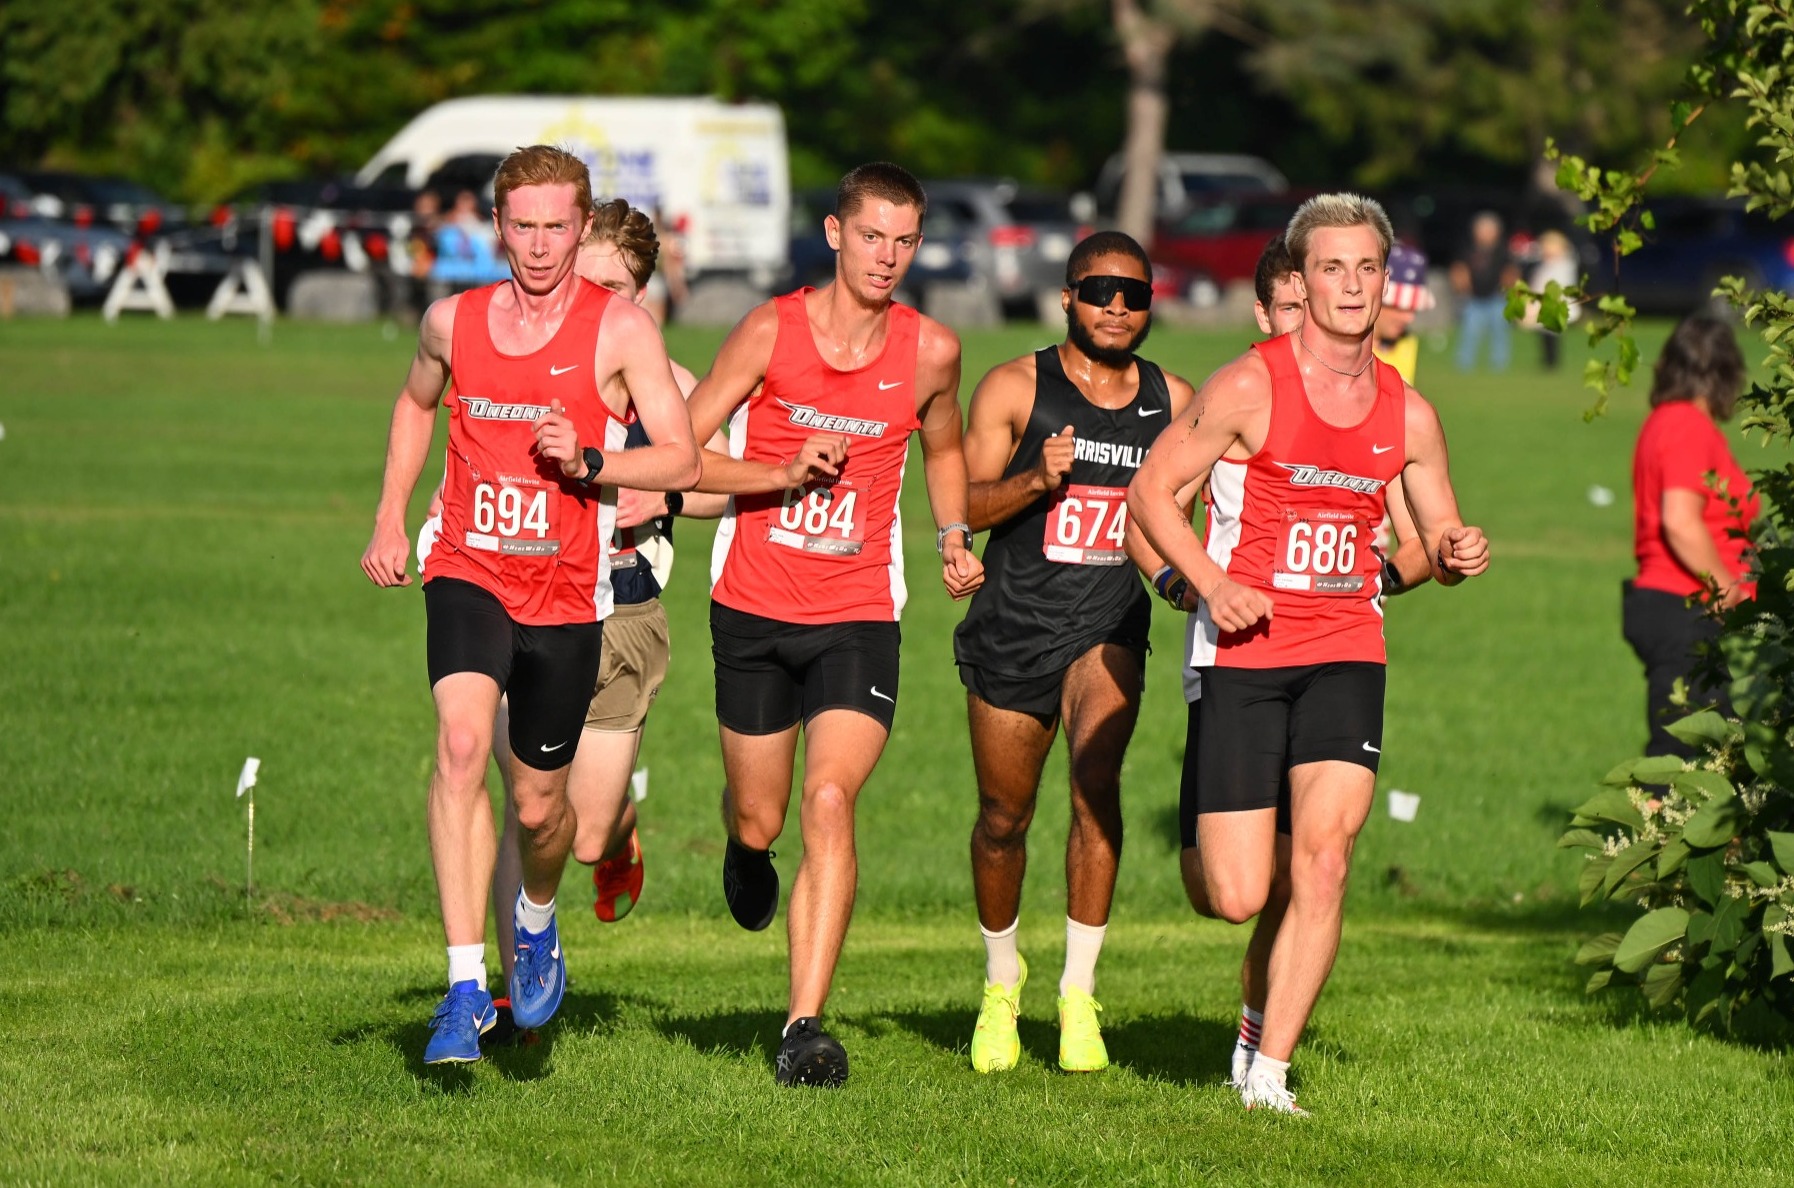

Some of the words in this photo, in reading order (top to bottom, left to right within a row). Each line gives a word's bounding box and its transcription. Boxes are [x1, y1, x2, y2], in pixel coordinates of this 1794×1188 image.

[459, 396, 560, 421] ONEONT
[776, 399, 887, 438] ONEONTA
[474, 483, 549, 538] 694
[780, 484, 858, 538] 684
[1057, 498, 1128, 548] 674
[1317, 512, 1340, 520] Airfield
[1286, 522, 1358, 574] 686
